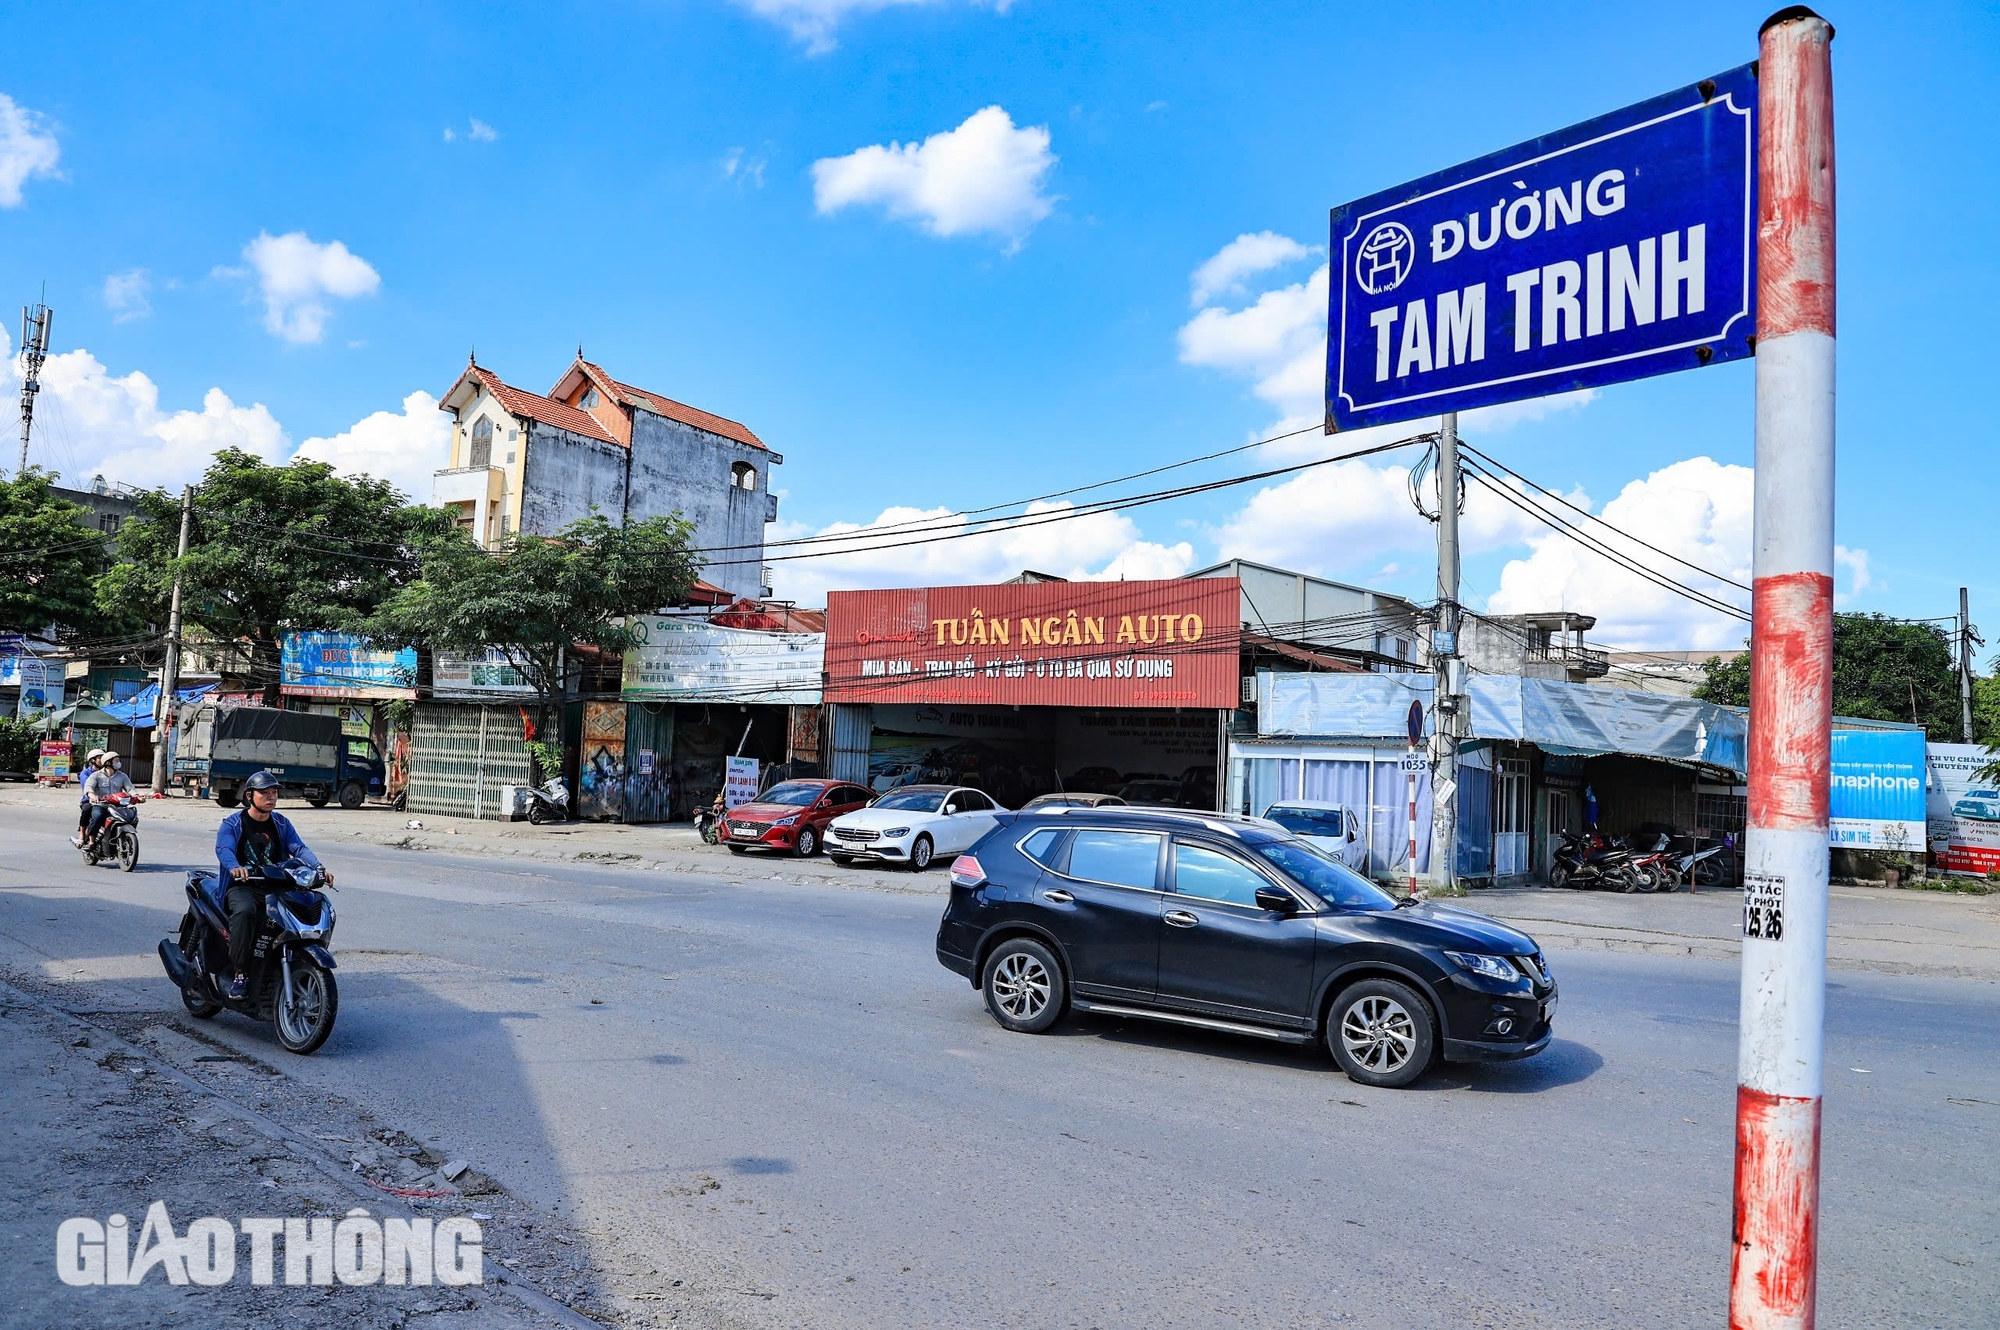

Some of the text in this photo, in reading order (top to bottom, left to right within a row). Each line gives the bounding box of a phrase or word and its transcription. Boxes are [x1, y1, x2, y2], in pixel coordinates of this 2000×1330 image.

[1430, 169, 1627, 262] ĐƯỜNG
[1373, 281, 1396, 295] HÀ NỘI
[1370, 223, 1707, 382] TAM TRINH
[656, 621, 682, 631] Gara
[932, 607, 1010, 646] TUẤN
[1021, 609, 1106, 646] NGÂN
[1117, 613, 1204, 644] AUTO
[322, 644, 348, 663] ĐỨC
[862, 659, 885, 677] MUA
[888, 657, 911, 677] BÁN
[925, 660, 953, 678] TRAO
[956, 654, 975, 678] ĐỔI
[986, 656, 1001, 678] KÝ
[1036, 657, 1045, 678] Ô
[1049, 657, 1063, 678] TÔ
[1087, 659, 1111, 680] QUA
[1137, 659, 1173, 682] DỤNG
[949, 712, 974, 726] AUTO
[1400, 760, 1426, 770] 1035
[1931, 763, 1970, 771] CHUYÊN
[1830, 772, 1920, 790] inaphone
[1841, 830, 1856, 843] SIM
[1754, 896, 1782, 908] PHỐT
